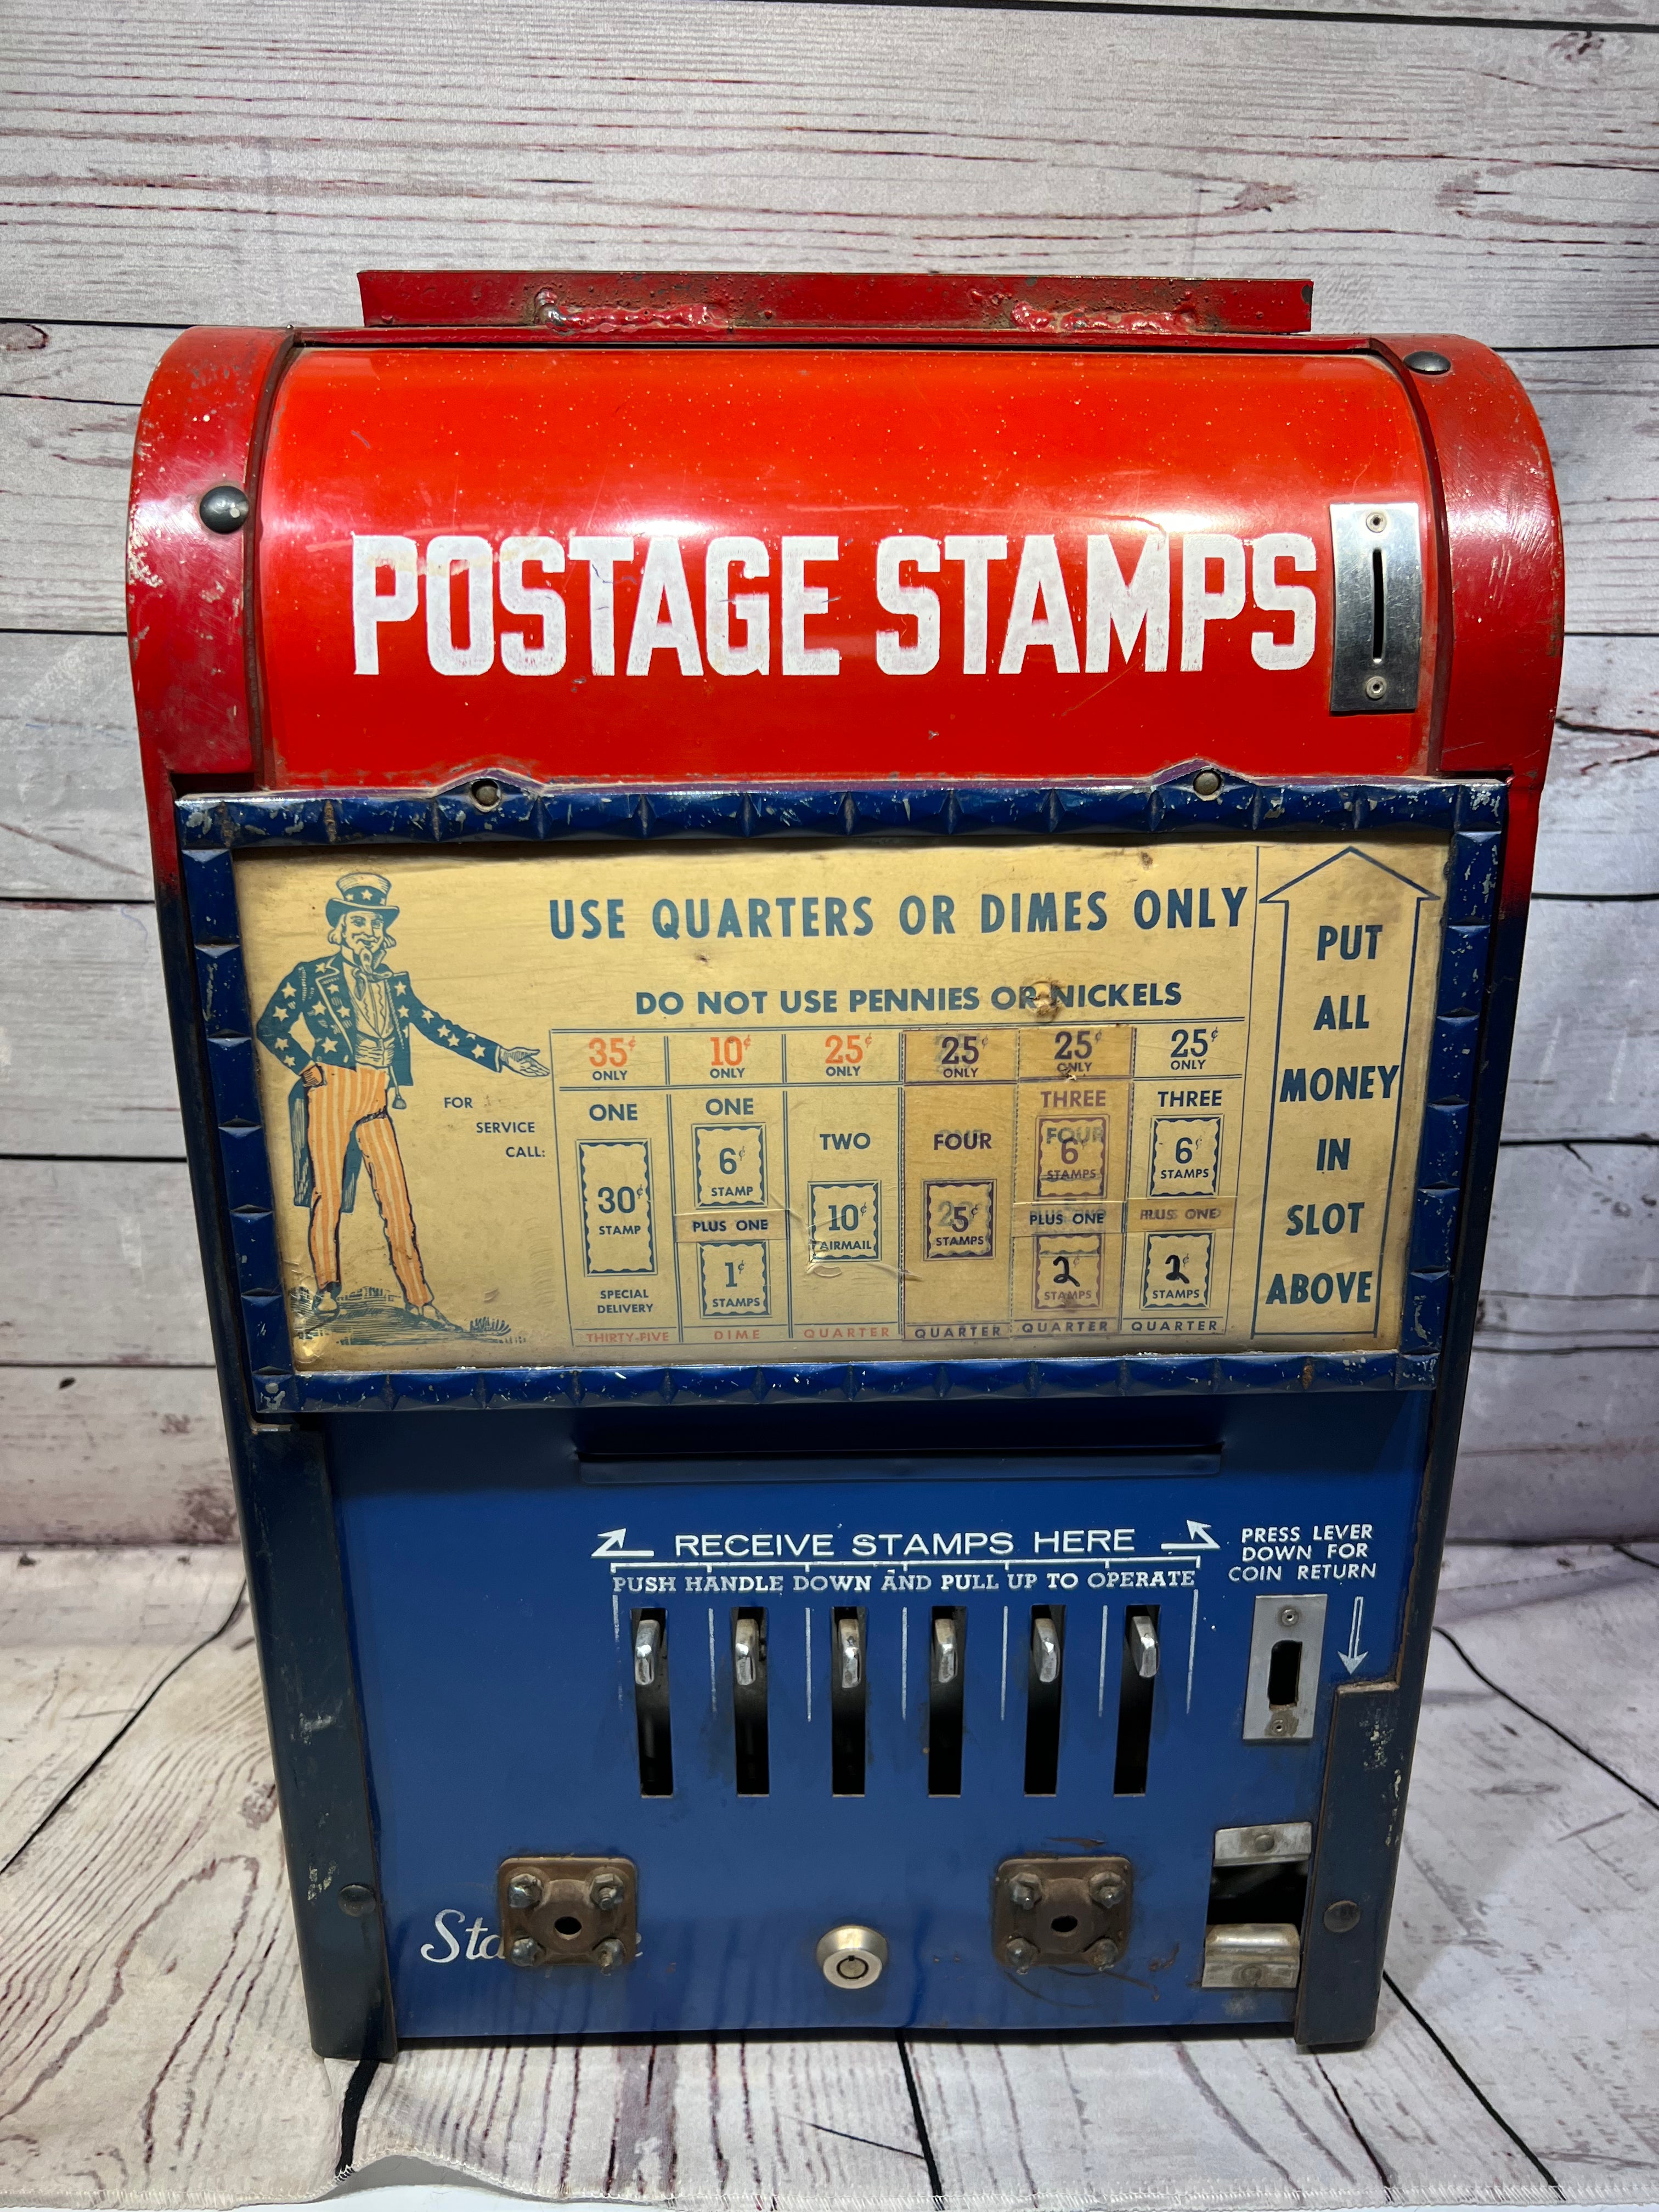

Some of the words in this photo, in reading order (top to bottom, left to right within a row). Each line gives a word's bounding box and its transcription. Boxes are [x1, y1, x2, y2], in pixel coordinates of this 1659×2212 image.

[352, 532, 840, 675] POSTAGE
[875, 532, 1317, 675] STAMPS
[550, 899, 625, 939] USE
[652, 896, 873, 939] QUARTERS
[899, 895, 955, 935] OR
[981, 891, 1107, 933] DIMES
[1134, 887, 1248, 929] ONLY
[1317, 925, 1383, 961] PUT
[636, 992, 684, 1014] DO
[697, 991, 768, 1014] NOT
[780, 990, 837, 1013] USE
[850, 988, 980, 1012] PENNIES
[991, 986, 1037, 1010] OR
[1059, 983, 1182, 1008] NICKELS
[1313, 995, 1369, 1030] ALL
[1057, 1062, 1092, 1073] ONLY
[1171, 1060, 1206, 1070] ONLY
[592, 1070, 628, 1081] ONLY
[709, 1068, 745, 1079] ONLY
[826, 1066, 861, 1077] ONLY
[943, 1068, 979, 1078] ONLY
[1280, 1065, 1400, 1103] MONEY
[444, 1097, 473, 1109] FOR
[1041, 1090, 1106, 1108] THREE
[1158, 1090, 1222, 1107] THREE
[589, 1104, 639, 1121] ONE
[706, 1098, 754, 1116] ONE
[476, 1121, 535, 1133] SERVICE
[820, 1132, 871, 1150] TWO
[934, 1133, 992, 1150] FOUR
[506, 1147, 545, 1158] CALL:
[1317, 1138, 1350, 1171] IN
[1047, 1169, 1097, 1180] STAMPS
[1160, 1169, 1209, 1179] STAMPS
[711, 1186, 754, 1197] STAMP
[1030, 1214, 1063, 1225] PLUS
[1072, 1212, 1105, 1224] ONE
[1184, 1208, 1221, 1220] ONE
[1286, 1202, 1364, 1237] SLOT
[599, 1225, 641, 1235] STAMP
[692, 1221, 726, 1233] PLUS
[736, 1220, 768, 1231] ONE
[820, 1240, 872, 1251] AIRMAIL
[935, 1236, 984, 1247] STAMPS
[600, 1289, 649, 1299] SPECIAL
[1265, 1271, 1373, 1305] ABOVE
[1044, 1290, 1092, 1300] STAMPS
[1153, 1290, 1199, 1300] STAMPS
[712, 1297, 760, 1308] STAMPS
[597, 1304, 654, 1314] DELIVERY
[1022, 1321, 1108, 1333] QUARTER
[1131, 1320, 1217, 1331] QUARTER
[587, 1331, 669, 1343] THIRTY-FIVE
[714, 1329, 760, 1341] DIME
[804, 1327, 890, 1339] QUARTER
[915, 1326, 1001, 1339] QUARTER
[1242, 1526, 1301, 1544] PRESS
[1313, 1524, 1373, 1541] LEVER
[675, 1534, 834, 1557] RECEIVE
[852, 1531, 1013, 1557] STAMPS
[1034, 1528, 1135, 1553] HERE
[1242, 1545, 1312, 1562] DOWN
[1327, 1543, 1368, 1559] FOR
[1228, 1566, 1282, 1582] COIN
[1297, 1563, 1376, 1581] RETURN
[612, 1576, 676, 1593] PUSH
[685, 1576, 784, 1593] HANDLE
[793, 1576, 872, 1592] DOWN
[881, 1575, 932, 1591] AND
[941, 1574, 999, 1590] PULL
[1007, 1573, 1037, 1590] UP
[1047, 1573, 1078, 1589] TO
[1087, 1571, 1195, 1588] OPERATE
